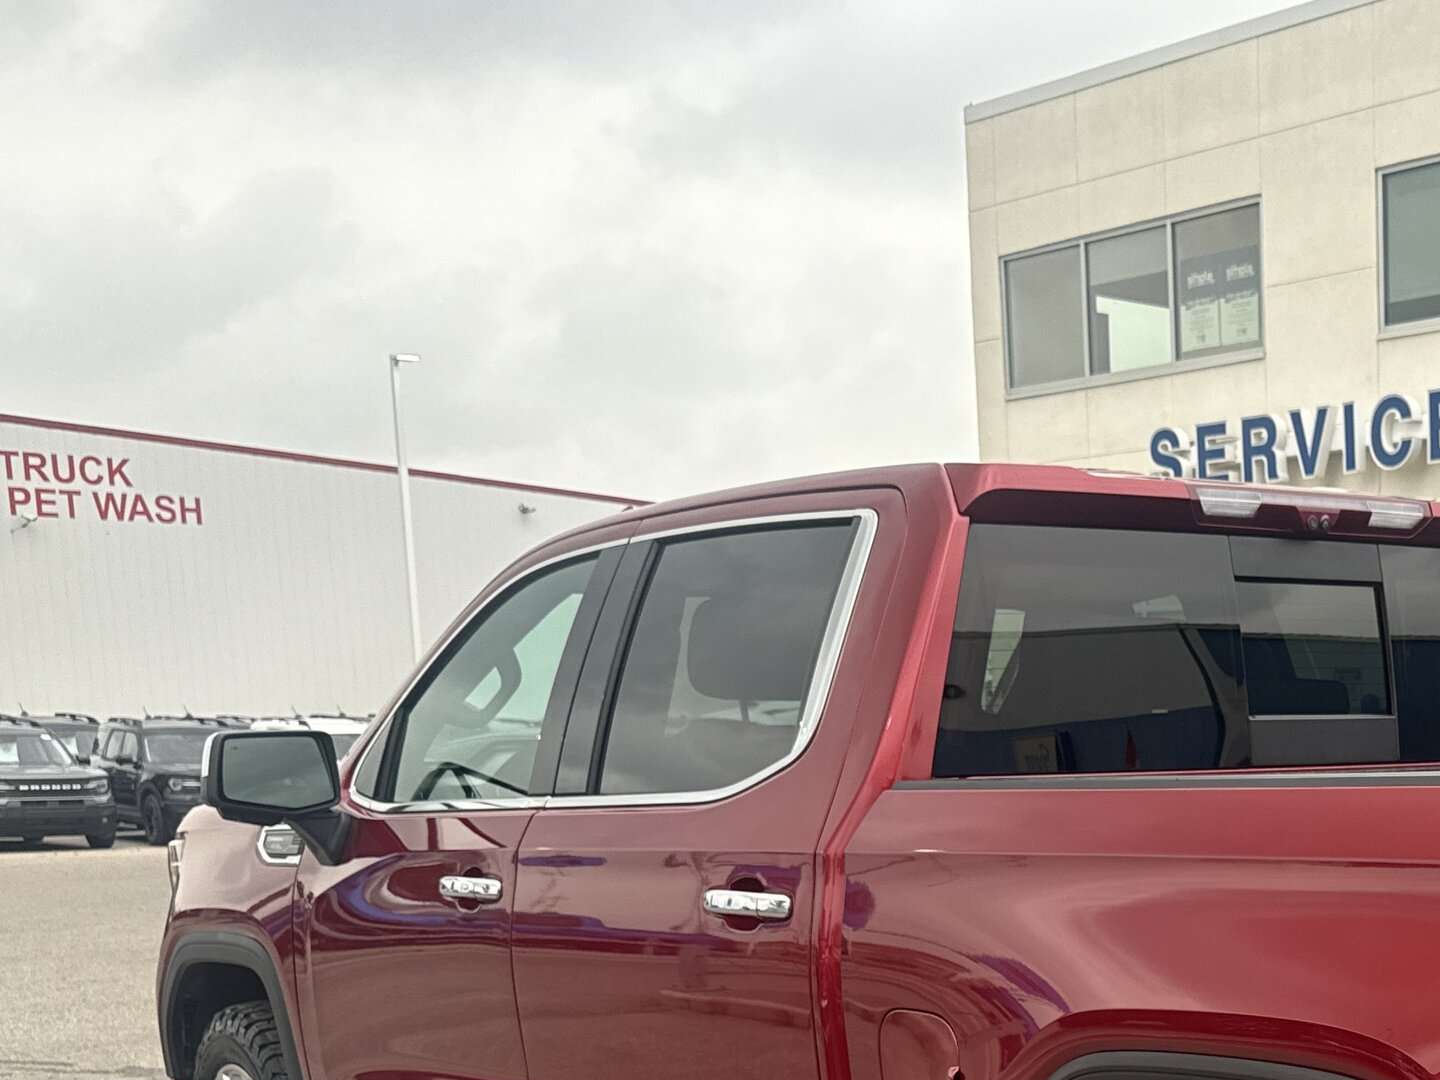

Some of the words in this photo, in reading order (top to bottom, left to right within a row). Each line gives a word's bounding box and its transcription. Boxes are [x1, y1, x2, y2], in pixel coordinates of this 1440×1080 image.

[0, 451, 134, 488] TRUCK
[8, 486, 82, 520] PET
[92, 491, 204, 526] WASH
